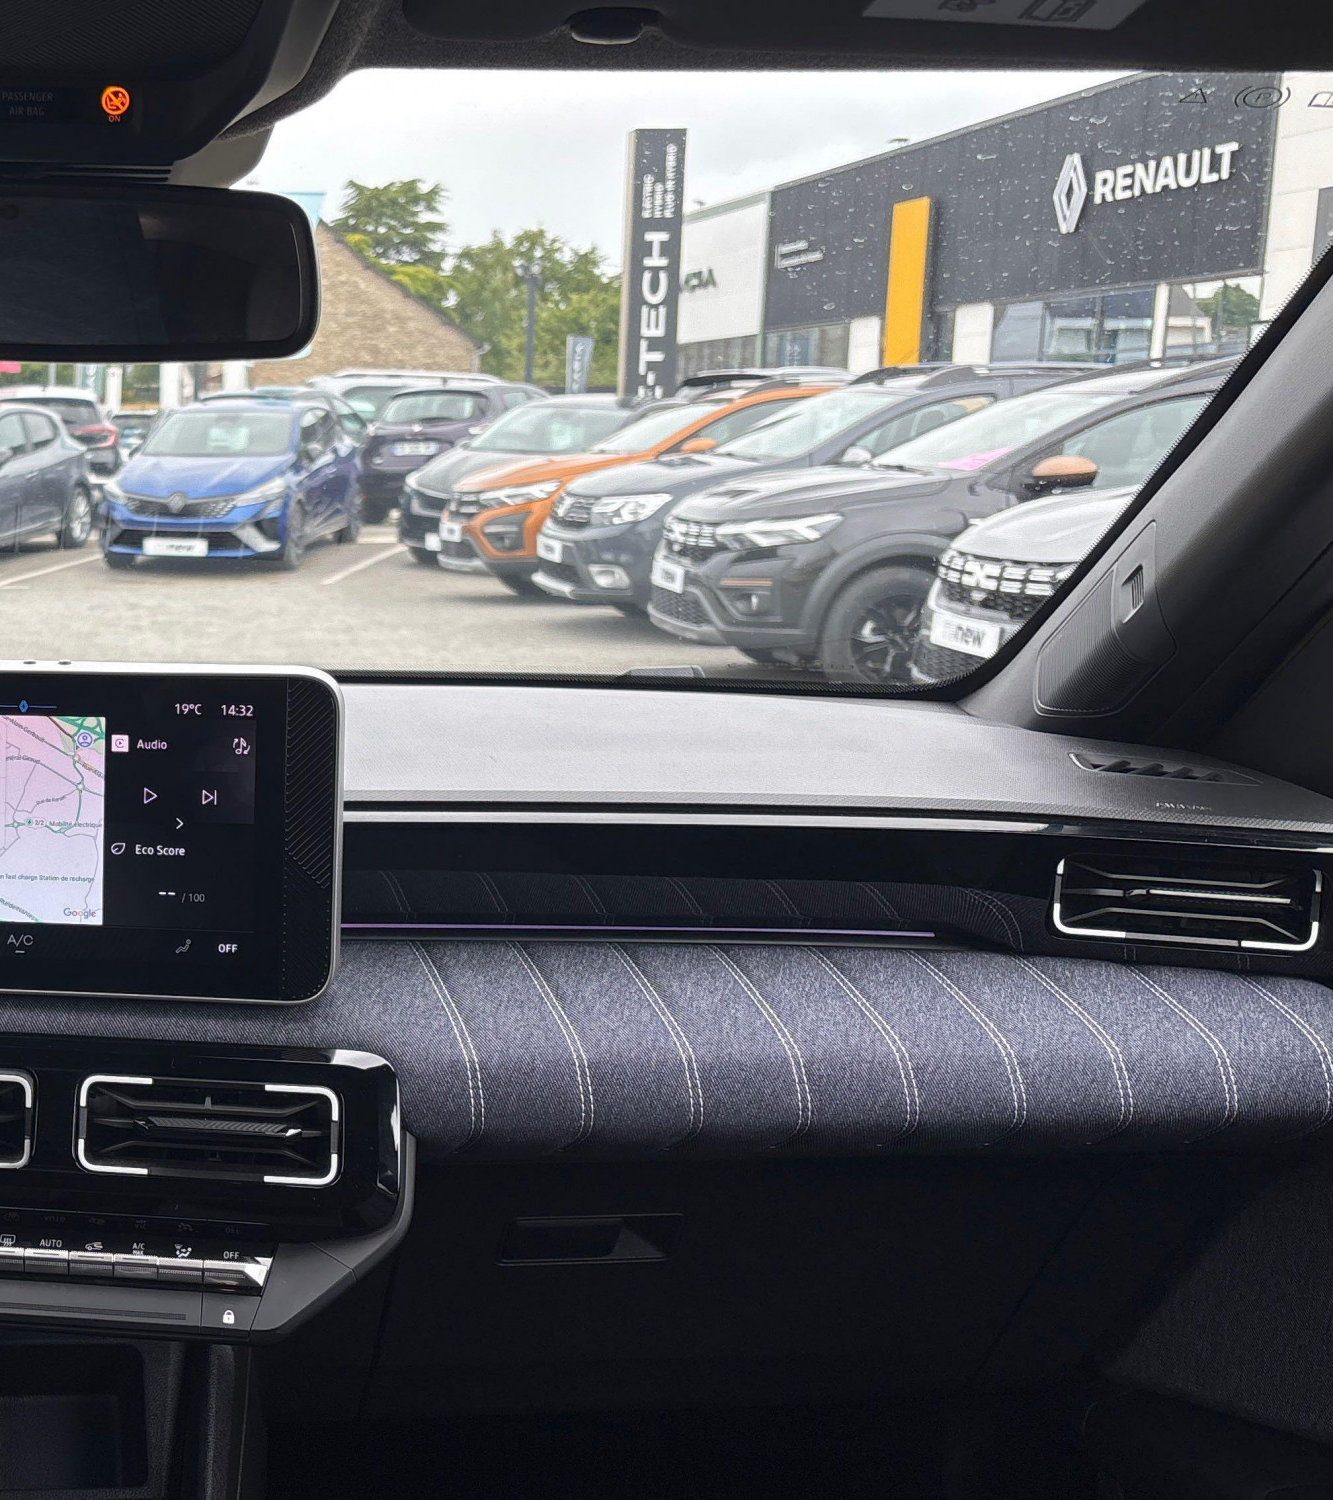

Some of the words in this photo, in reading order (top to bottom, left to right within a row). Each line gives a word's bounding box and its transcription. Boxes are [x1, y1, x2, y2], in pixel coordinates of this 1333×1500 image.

[2, 91, 53, 102] PASSENGER
[9, 107, 24, 116] AIR
[27, 107, 44, 116] BAG
[108, 115, 121, 123] ON
[1094, 141, 1239, 204] RENAULT
[221, 705, 253, 716] 14:32
[137, 739, 168, 750] Audio
[135, 845, 154, 855] Eco
[156, 845, 185, 856] Score
[18, 874, 38, 882] charge
[188, 893, 205, 902] 100
[63, 907, 97, 919] Google
[7, 934, 34, 946] A/C
[219, 944, 237, 953] OFF
[40, 1239, 63, 1248] AUTO
[132, 1242, 145, 1250] A/C
[223, 1251, 239, 1260] OFF
